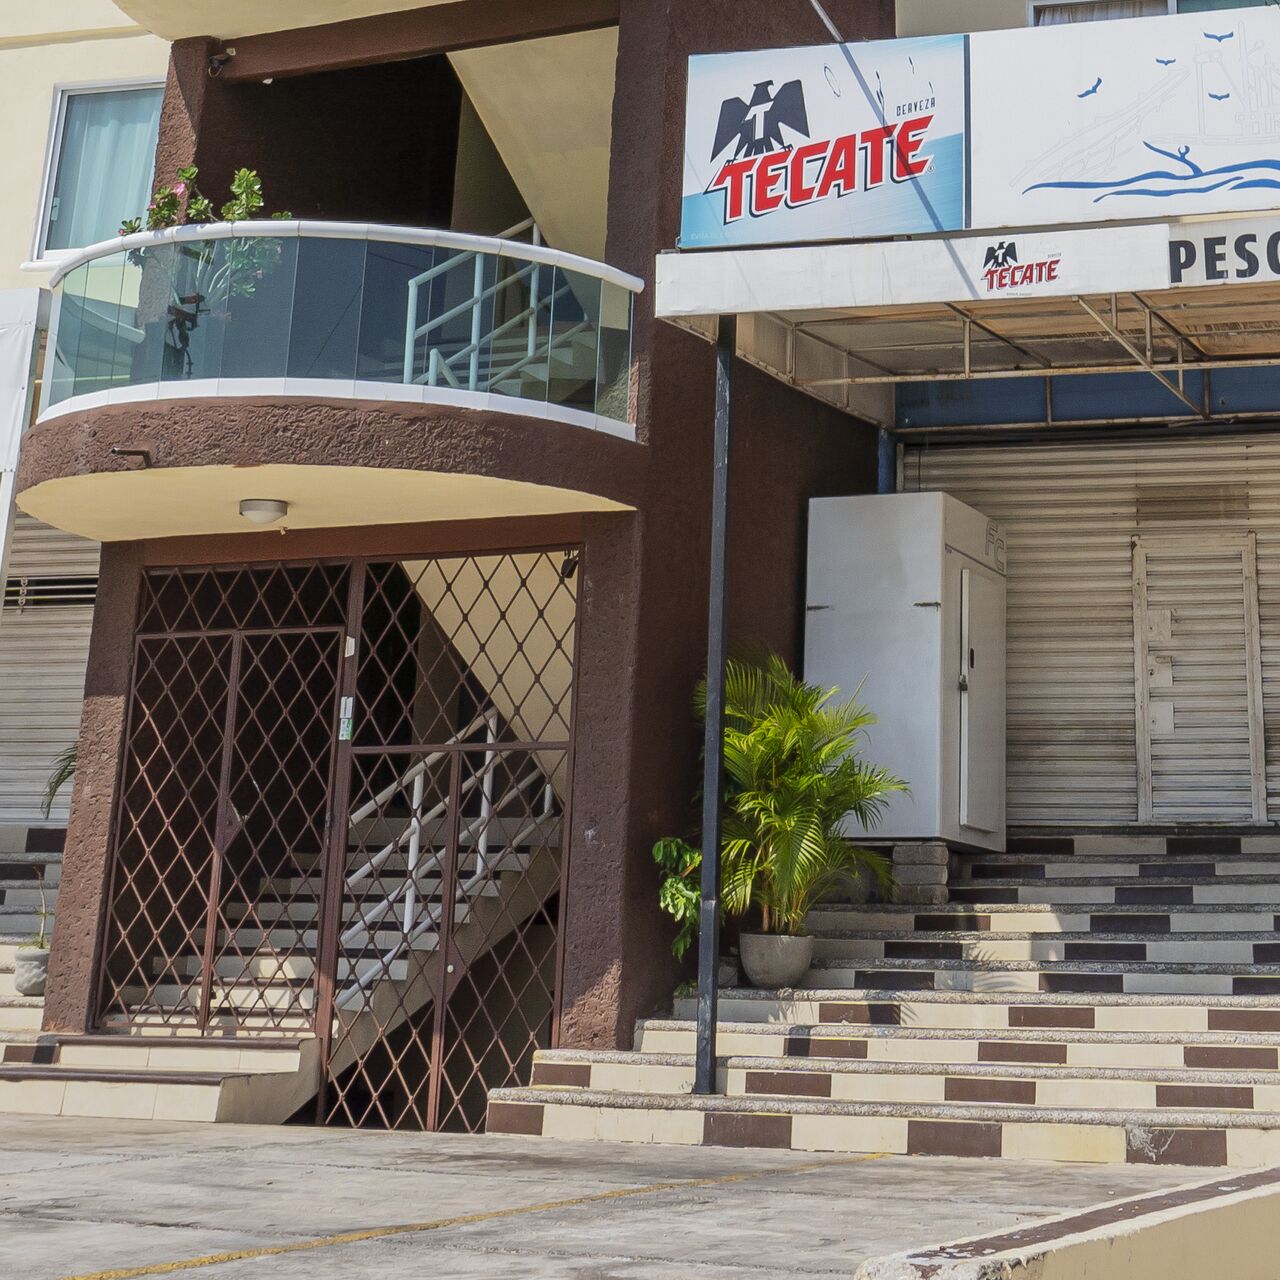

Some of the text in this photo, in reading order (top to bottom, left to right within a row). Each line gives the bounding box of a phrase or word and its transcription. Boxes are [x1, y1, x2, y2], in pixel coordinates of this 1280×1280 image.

[896, 97, 935, 117] CERVEZA
[708, 115, 934, 221] TECATE
[982, 259, 1061, 291] TECATE
